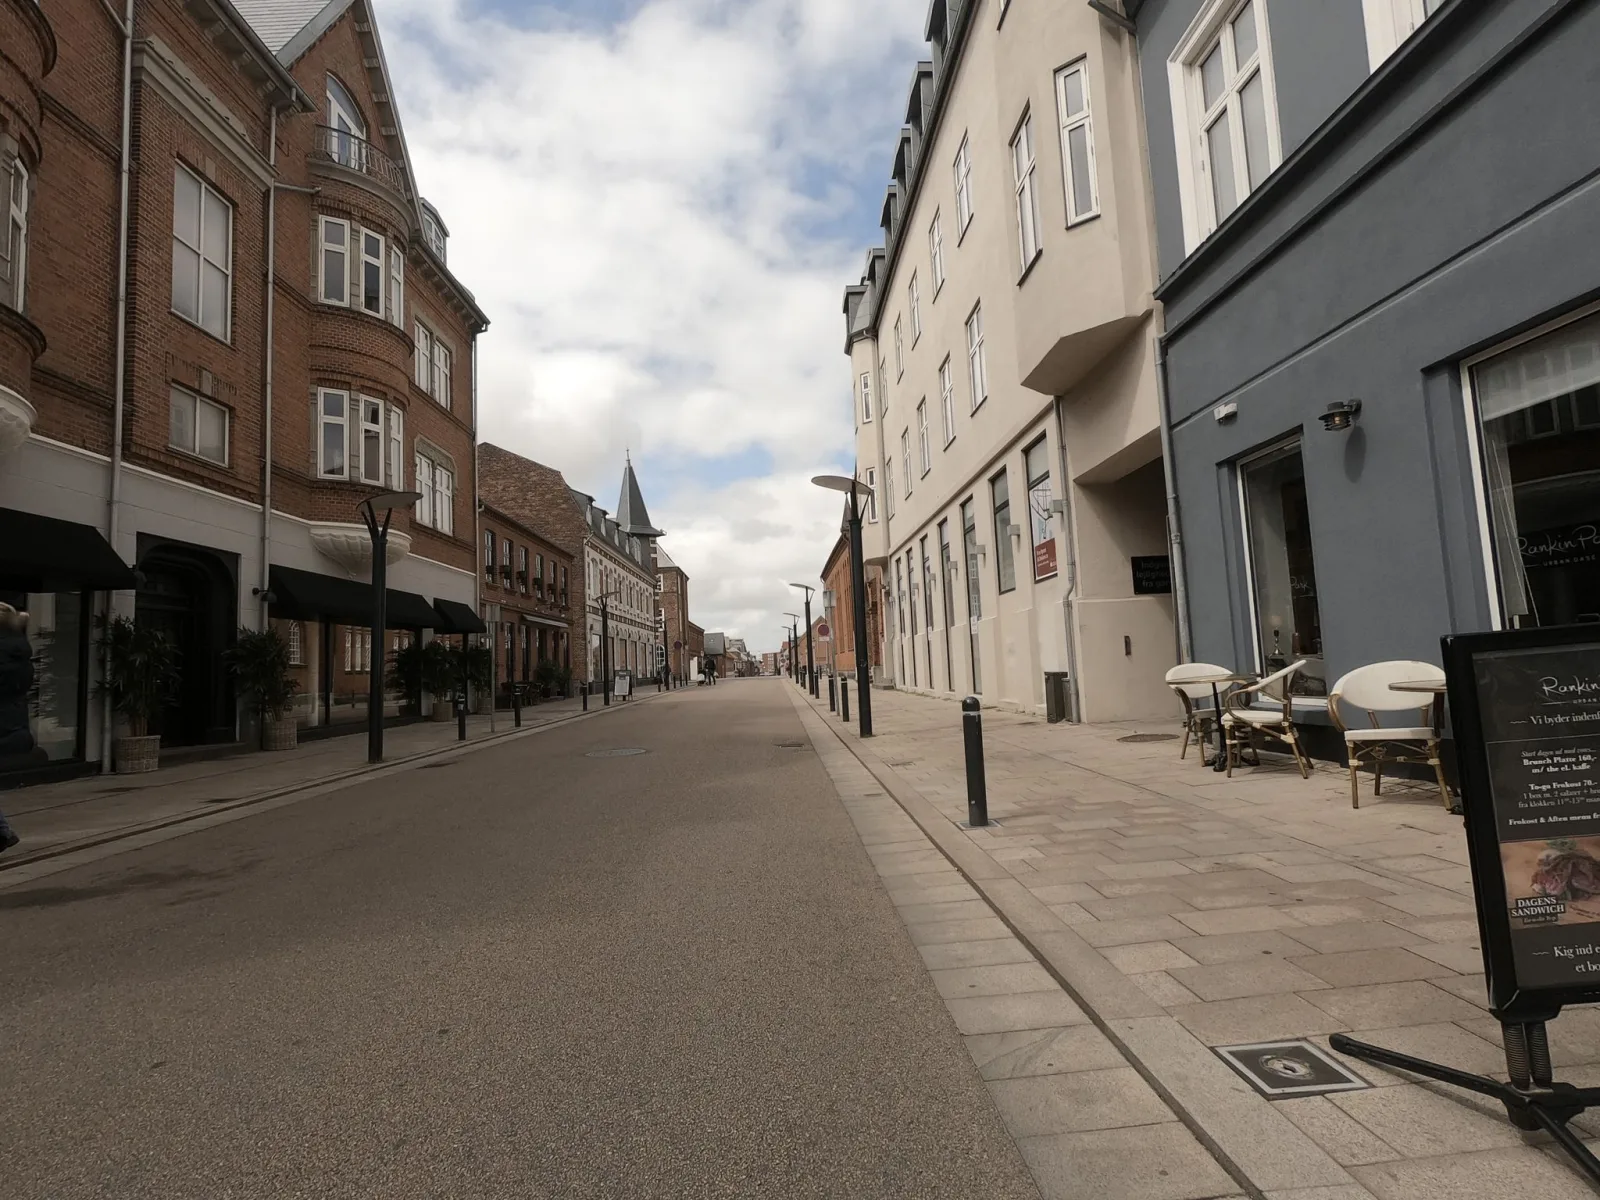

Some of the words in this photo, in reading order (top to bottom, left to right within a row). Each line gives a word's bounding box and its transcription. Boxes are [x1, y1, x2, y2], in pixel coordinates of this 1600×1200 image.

[1516, 532, 1577, 557] Rankin
[1538, 675, 1600, 697] Rankin
[1530, 715, 1543, 725] Vi
[1543, 713, 1571, 727] byder
[1522, 757, 1552, 766] Brunch
[1572, 762, 1591, 771] kaffe
[1552, 781, 1582, 789] Frokost
[1508, 817, 1538, 826] Frokost
[1547, 815, 1568, 823] Aften
[1517, 896, 1557, 908] DAGENS
[1511, 904, 1565, 917] SANDWICH
[1553, 945, 1575, 959] Kig
[1574, 943, 1593, 955] ind
[1575, 963, 1586, 973] et
